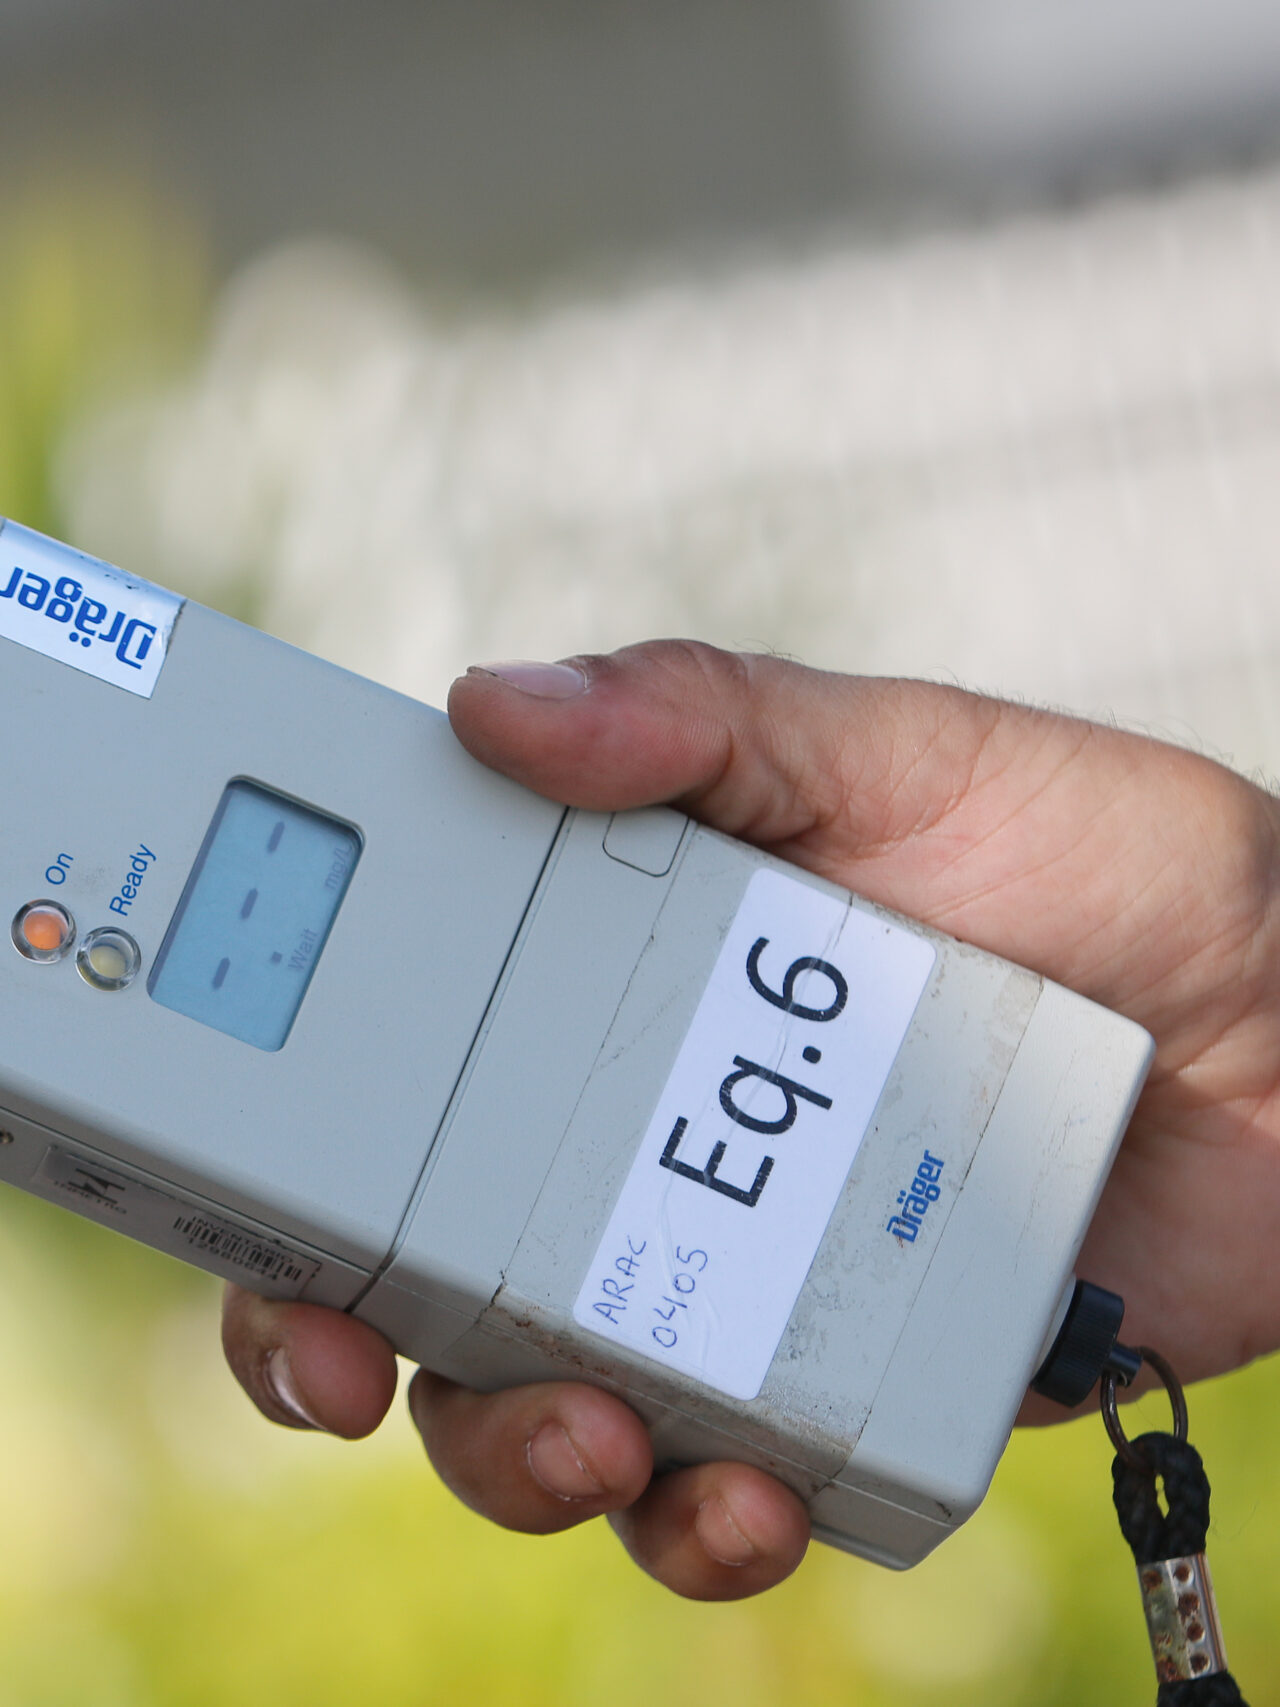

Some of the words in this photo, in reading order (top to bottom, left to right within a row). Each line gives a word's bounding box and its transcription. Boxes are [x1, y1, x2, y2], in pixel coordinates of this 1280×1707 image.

[45, 853, 74, 885] On
[109, 843, 157, 917] Ready
[886, 1149, 945, 1243] Dräger
[651, 1246, 708, 1349] 0405
